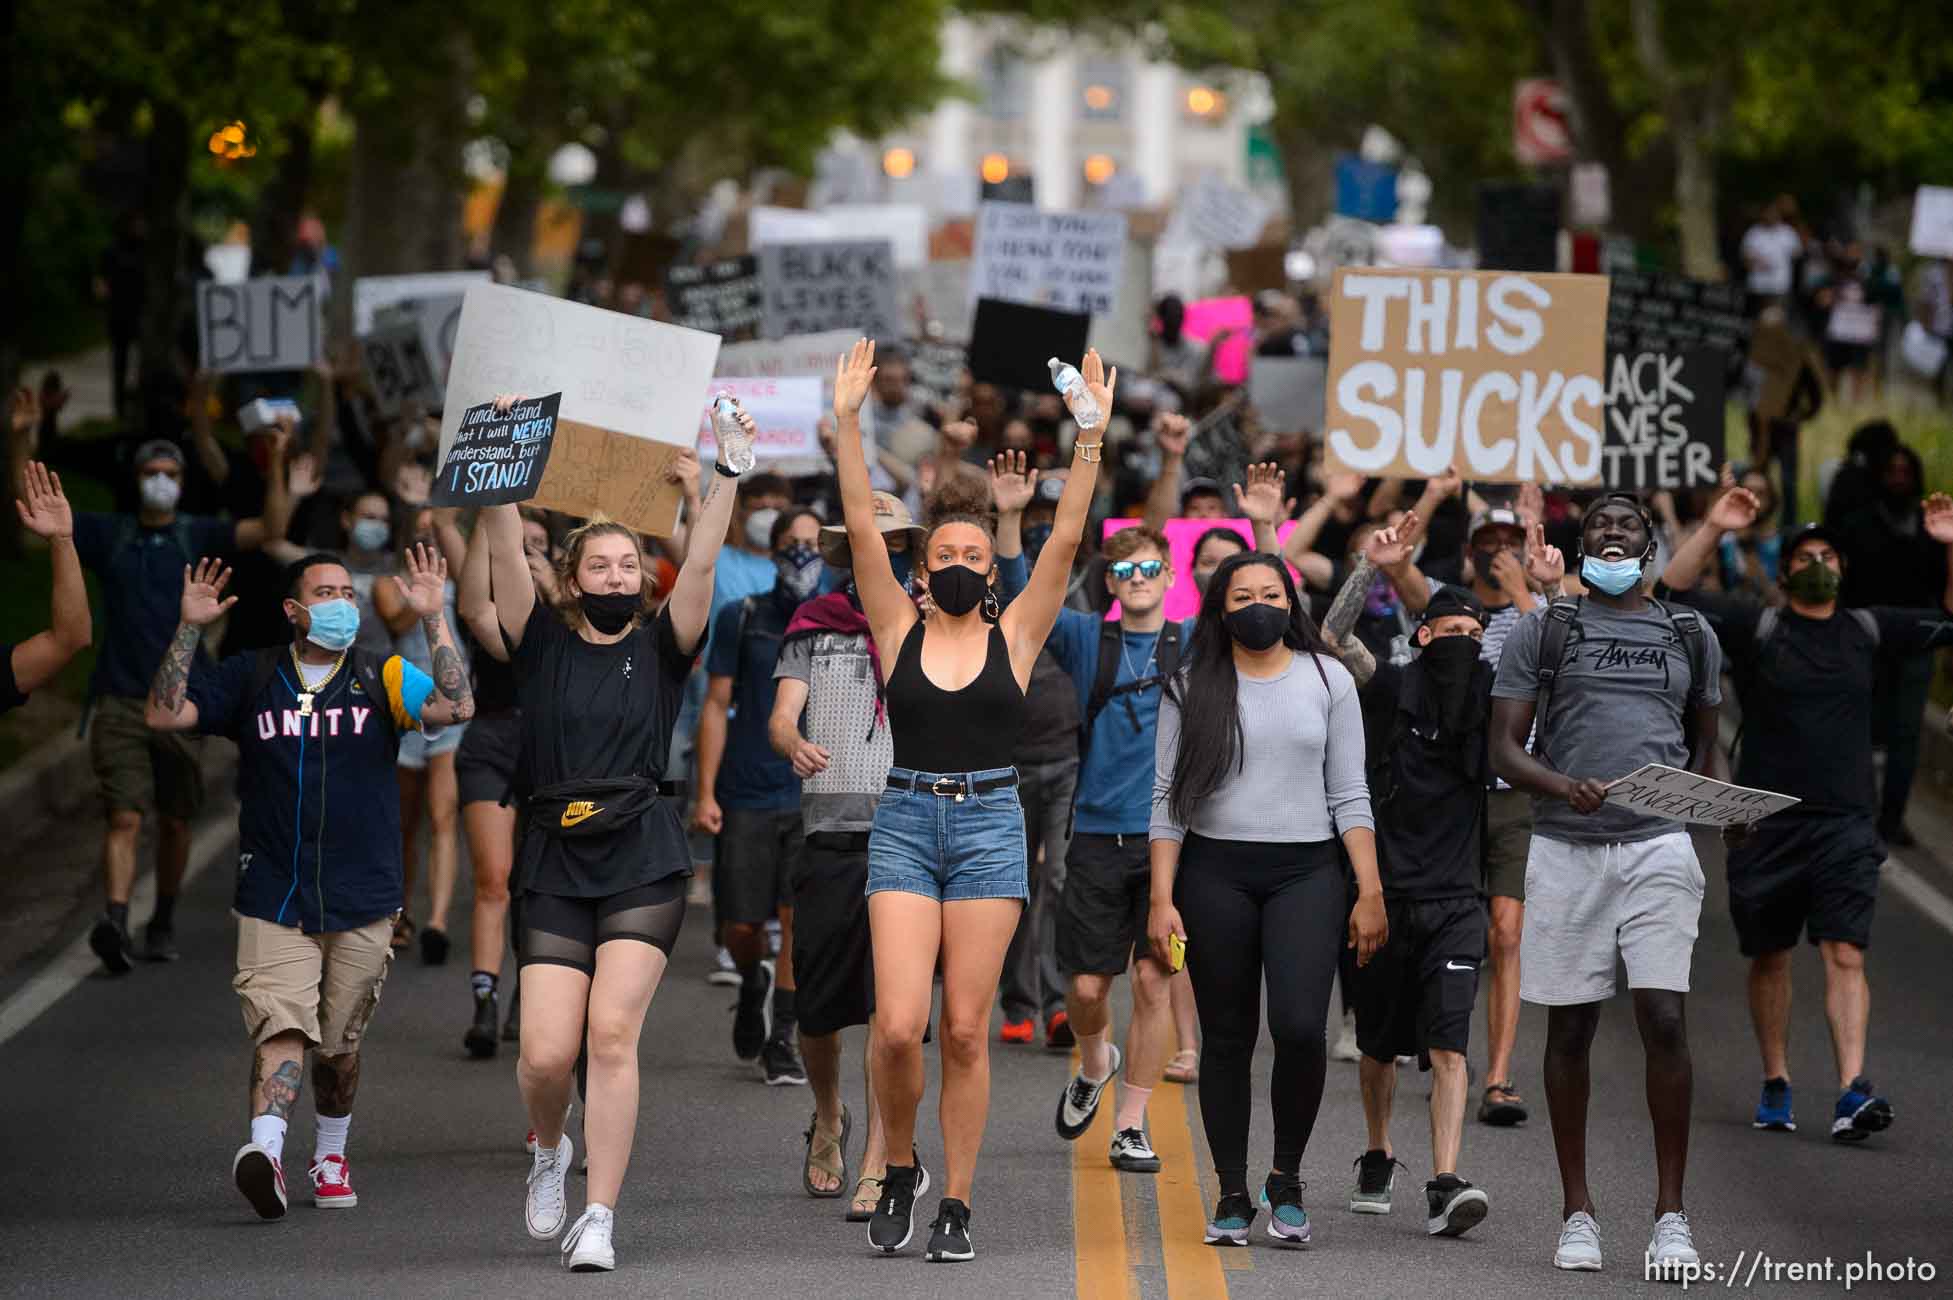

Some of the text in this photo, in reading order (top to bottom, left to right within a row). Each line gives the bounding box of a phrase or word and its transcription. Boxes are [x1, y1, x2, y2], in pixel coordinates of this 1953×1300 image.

[783, 246, 889, 281] BLACK
[204, 284, 316, 368] BLM
[1343, 274, 1552, 355] THIS
[1602, 352, 1695, 406] ACK
[455, 416, 553, 444] hat I will NEVER
[463, 400, 543, 428] I undestand
[1329, 360, 1602, 484] SUCKS
[1610, 403, 1689, 449] VES
[519, 443, 540, 459] but
[1601, 442, 1718, 488] TTER
[451, 460, 534, 493] I STAND!
[257, 706, 371, 741] UNITY
[566, 801, 595, 816] NIKE
